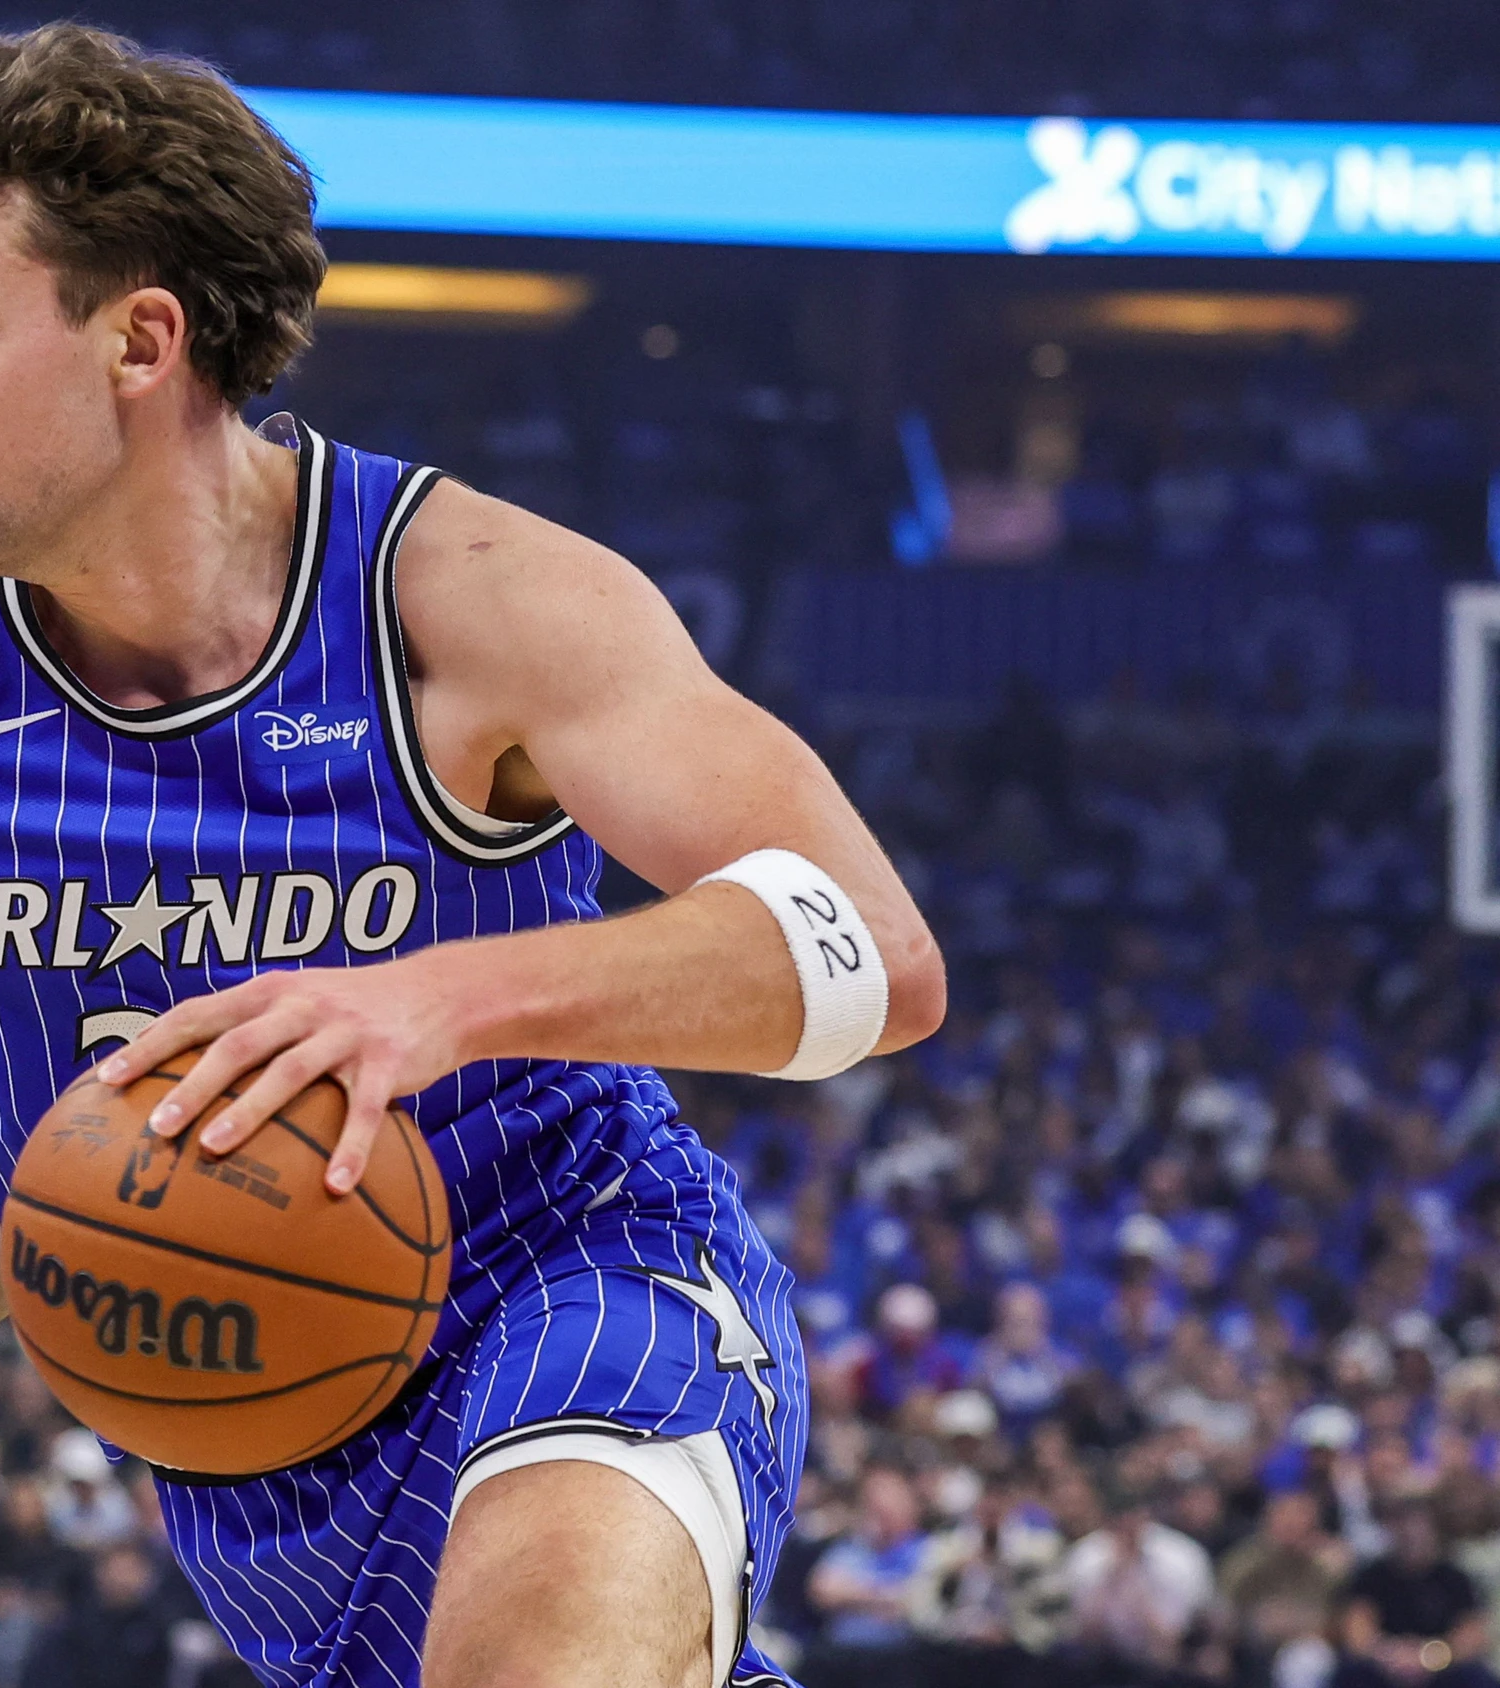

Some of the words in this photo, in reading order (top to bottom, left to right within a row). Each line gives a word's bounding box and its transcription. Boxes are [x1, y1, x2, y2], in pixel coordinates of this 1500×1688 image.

[1134, 142, 1327, 253] City
[790, 888, 861, 979] 22
[12, 1226, 265, 1374] Wilson
